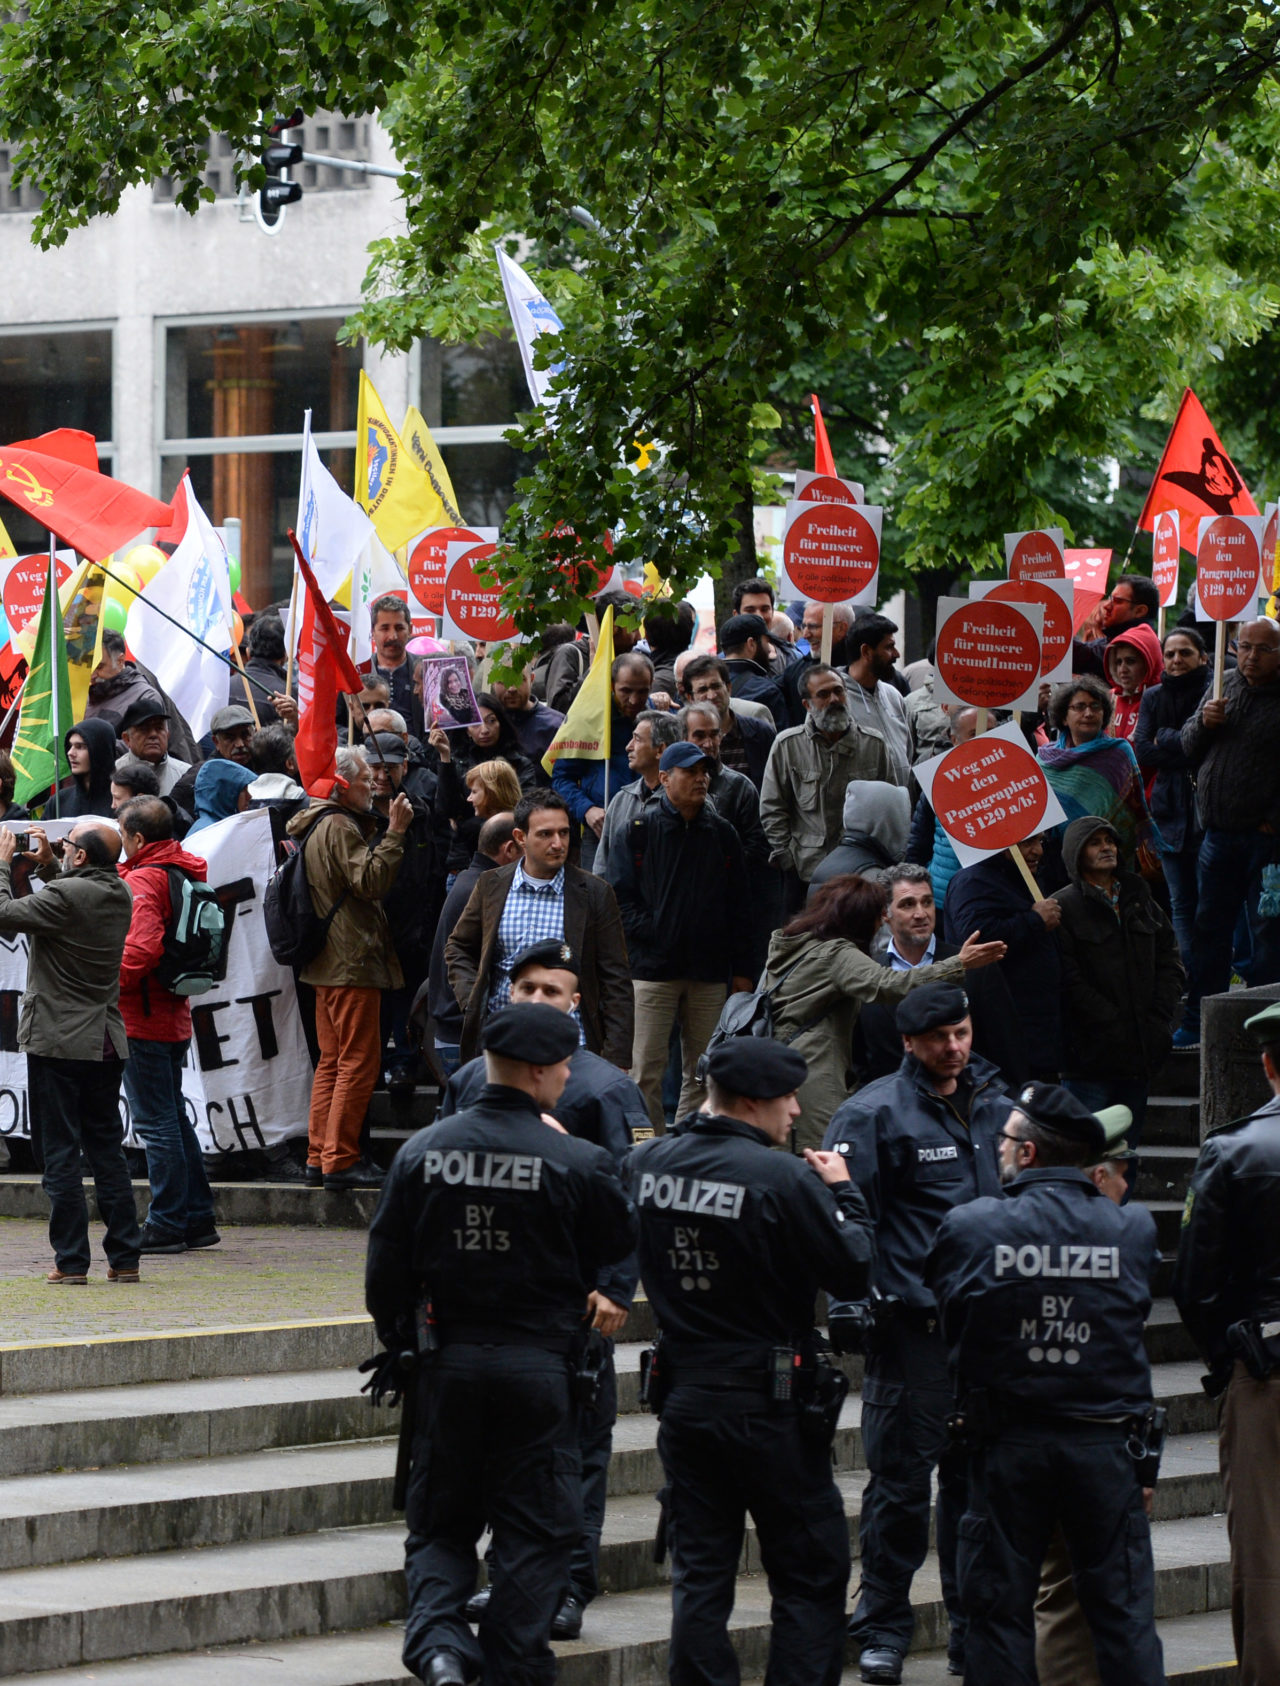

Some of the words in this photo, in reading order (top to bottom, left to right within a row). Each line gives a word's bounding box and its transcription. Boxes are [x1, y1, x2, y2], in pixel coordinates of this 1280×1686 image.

[807, 523, 858, 538] Freiheit
[1208, 533, 1226, 546] Weg
[1227, 533, 1246, 545] mit
[799, 538, 819, 551] für
[820, 541, 863, 554] unsere
[789, 552, 873, 569] FreundInnen
[1021, 551, 1053, 566] Freiheit
[1215, 550, 1232, 562] den
[423, 560, 442, 571] für
[1032, 569, 1057, 580] unsere
[1199, 566, 1256, 581] Paragraphen
[16, 571, 43, 583] Weg
[32, 585, 46, 597] de
[1203, 584, 1209, 598] §
[1209, 583, 1225, 596] 129
[1226, 583, 1247, 596] a/b!
[459, 605, 468, 620] §
[471, 605, 497, 618] 129
[962, 621, 1017, 638] Freiheit
[953, 637, 974, 650] für
[977, 641, 1023, 655] unsere
[942, 652, 1033, 672] FreundInnen
[943, 764, 981, 783] Weg
[980, 747, 1007, 767] mit
[970, 773, 999, 792] den
[944, 774, 1040, 825] Paragraphen
[964, 822, 976, 838] §
[975, 807, 1007, 830] 129
[1008, 792, 1038, 815] a/b!
[917, 1145, 958, 1163] POLIZEI
[423, 1150, 543, 1192] POLIZEI
[638, 1172, 746, 1220] POLIZEI
[465, 1204, 495, 1227] BY
[452, 1228, 511, 1252] 1213
[674, 1226, 701, 1248] BY
[667, 1249, 720, 1271] 1213
[994, 1244, 1120, 1279] POLIZEI
[1041, 1295, 1075, 1320] BY
[1019, 1319, 1038, 1341] M
[1042, 1319, 1092, 1345] 7140
